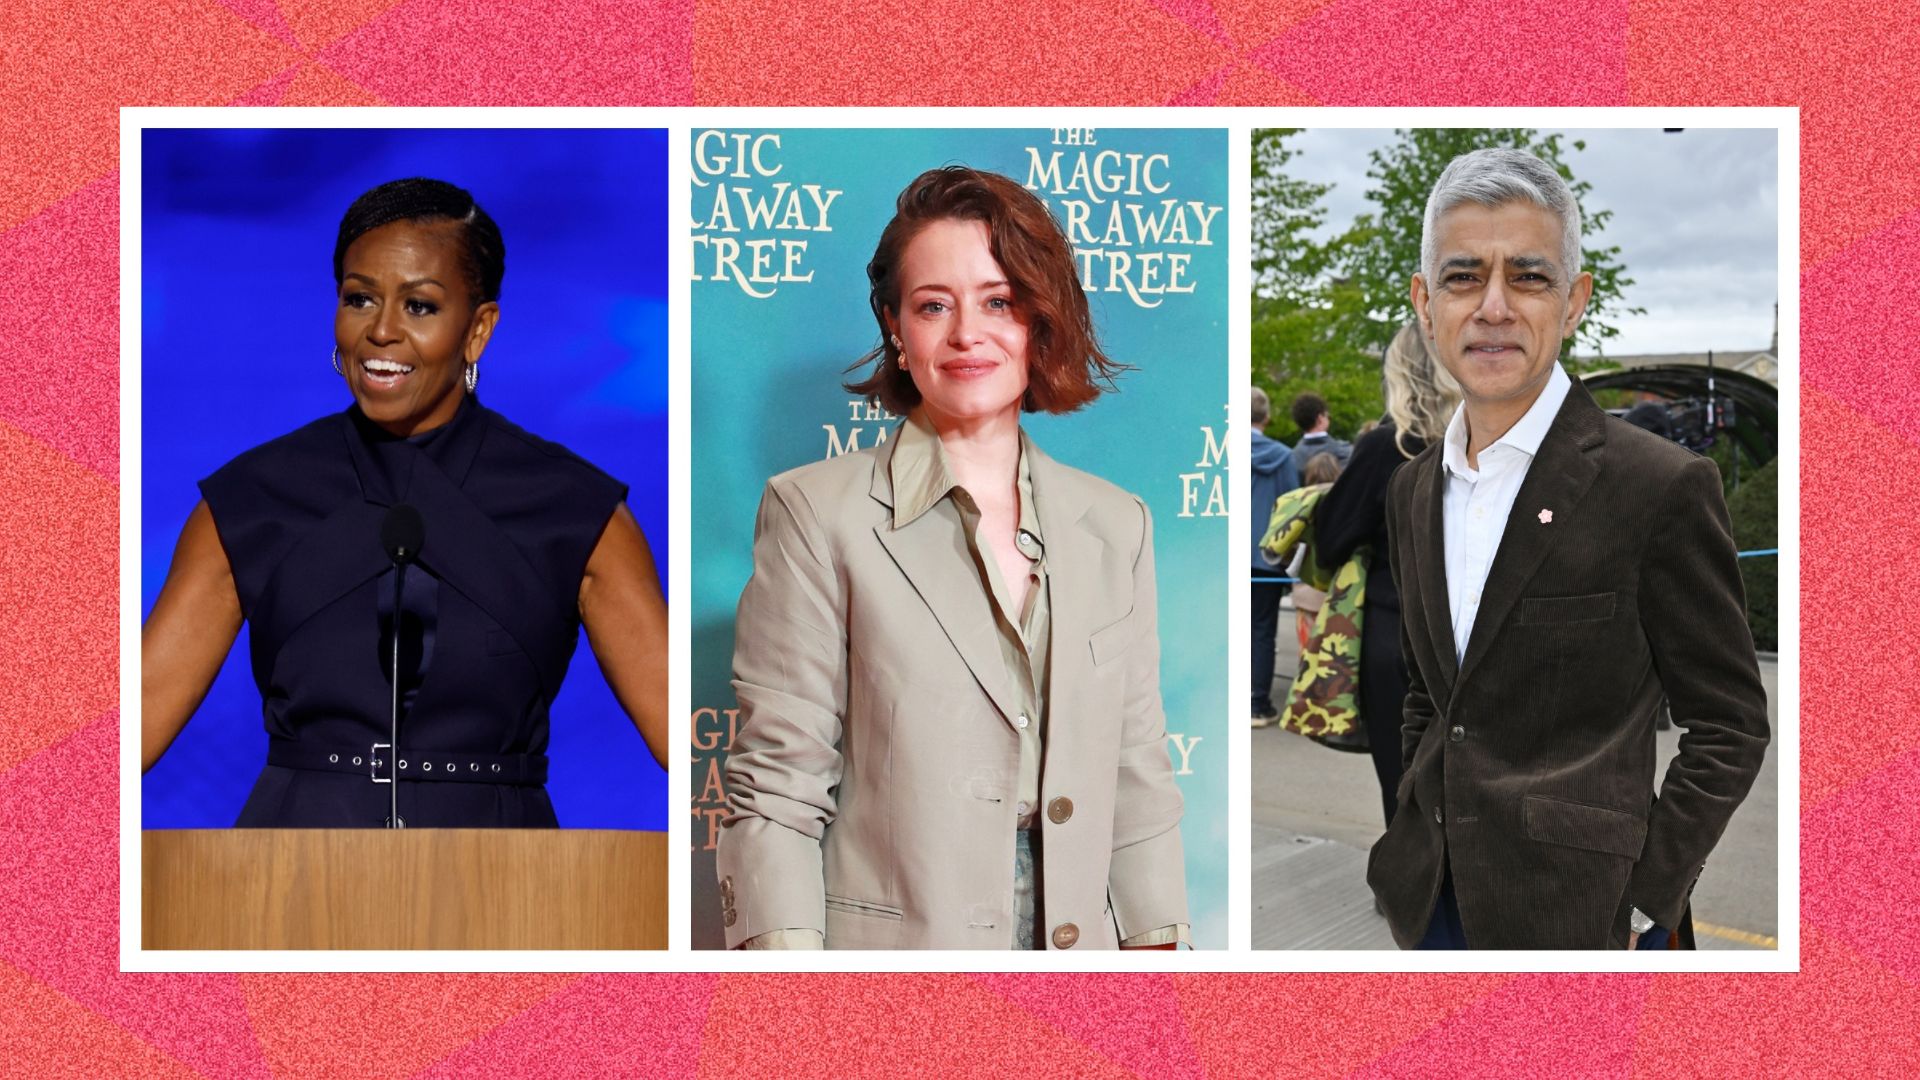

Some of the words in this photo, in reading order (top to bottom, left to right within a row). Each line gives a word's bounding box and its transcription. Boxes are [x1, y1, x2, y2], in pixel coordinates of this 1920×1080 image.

[691, 130, 783, 187] GIC
[1051, 128, 1098, 146] THE
[1023, 147, 1171, 204] MAGIC
[1074, 248, 1197, 308] TREE
